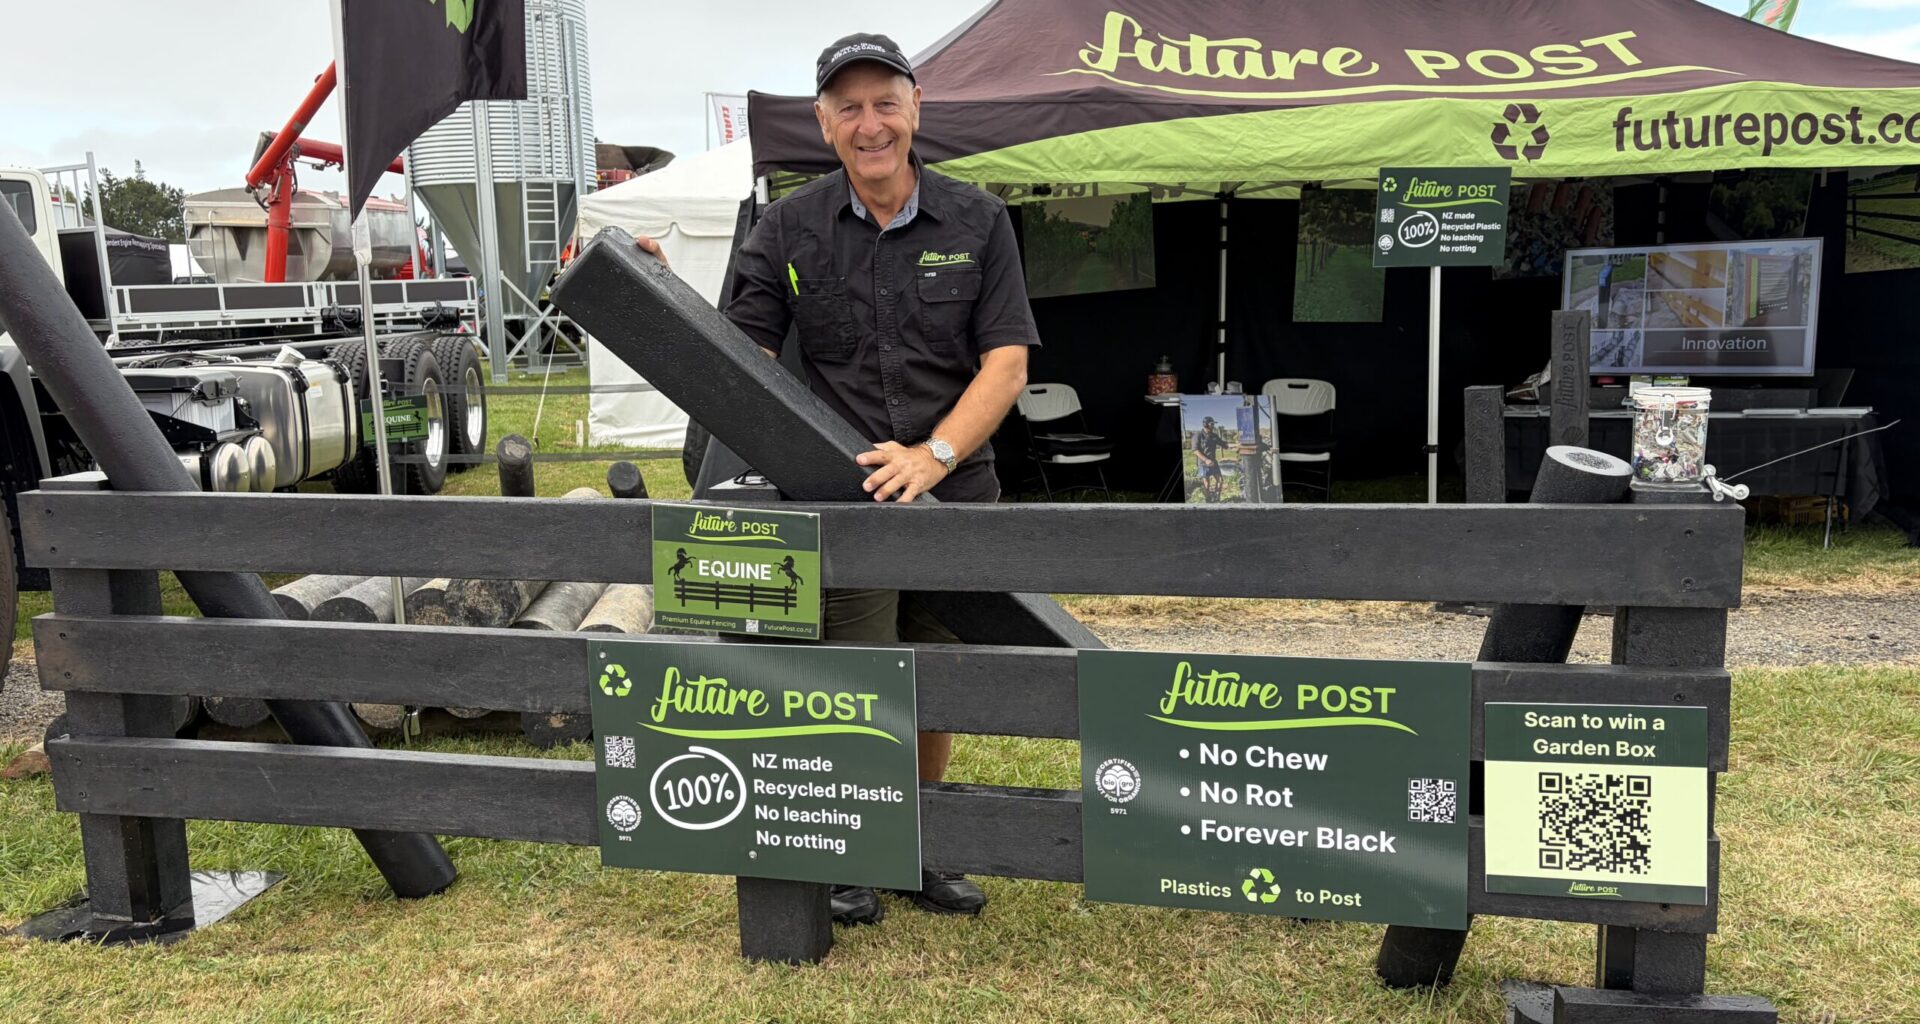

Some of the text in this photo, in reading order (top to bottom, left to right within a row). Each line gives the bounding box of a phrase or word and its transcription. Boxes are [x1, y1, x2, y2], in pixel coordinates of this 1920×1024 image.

[1078, 11, 1643, 80] future POST
[1403, 176, 1497, 202] future POST
[1442, 212, 1475, 220] NZ made
[1403, 221, 1435, 241] 100%
[1441, 222, 1502, 232] Recycled Plastic
[1440, 233, 1484, 243] No leaching
[919, 250, 971, 264] future POST
[1439, 245, 1477, 254] No rotting
[1682, 336, 1767, 351] Innovation
[384, 414, 411, 425] QUINE
[689, 511, 779, 536] future POST
[698, 559, 772, 580] EQUINE
[661, 614, 737, 628] Premium Equine Fencing
[651, 666, 878, 722] future POST
[1160, 662, 1396, 714] future POST
[1524, 711, 1665, 731] Scan to win a
[1199, 743, 1328, 771] No Chew
[1533, 738, 1656, 758] Garden Box
[752, 752, 833, 772] NZ made
[662, 772, 734, 812] 100%
[753, 779, 903, 803] Recycled Plastic
[1200, 781, 1294, 808] No Rot
[755, 805, 861, 829] No leaching
[1110, 807, 1127, 815] 5971
[756, 830, 846, 855] No rotting
[1201, 819, 1397, 854] Forever Black
[1160, 878, 1362, 907] Plastics to Post
[1568, 881, 1619, 894] future POST
